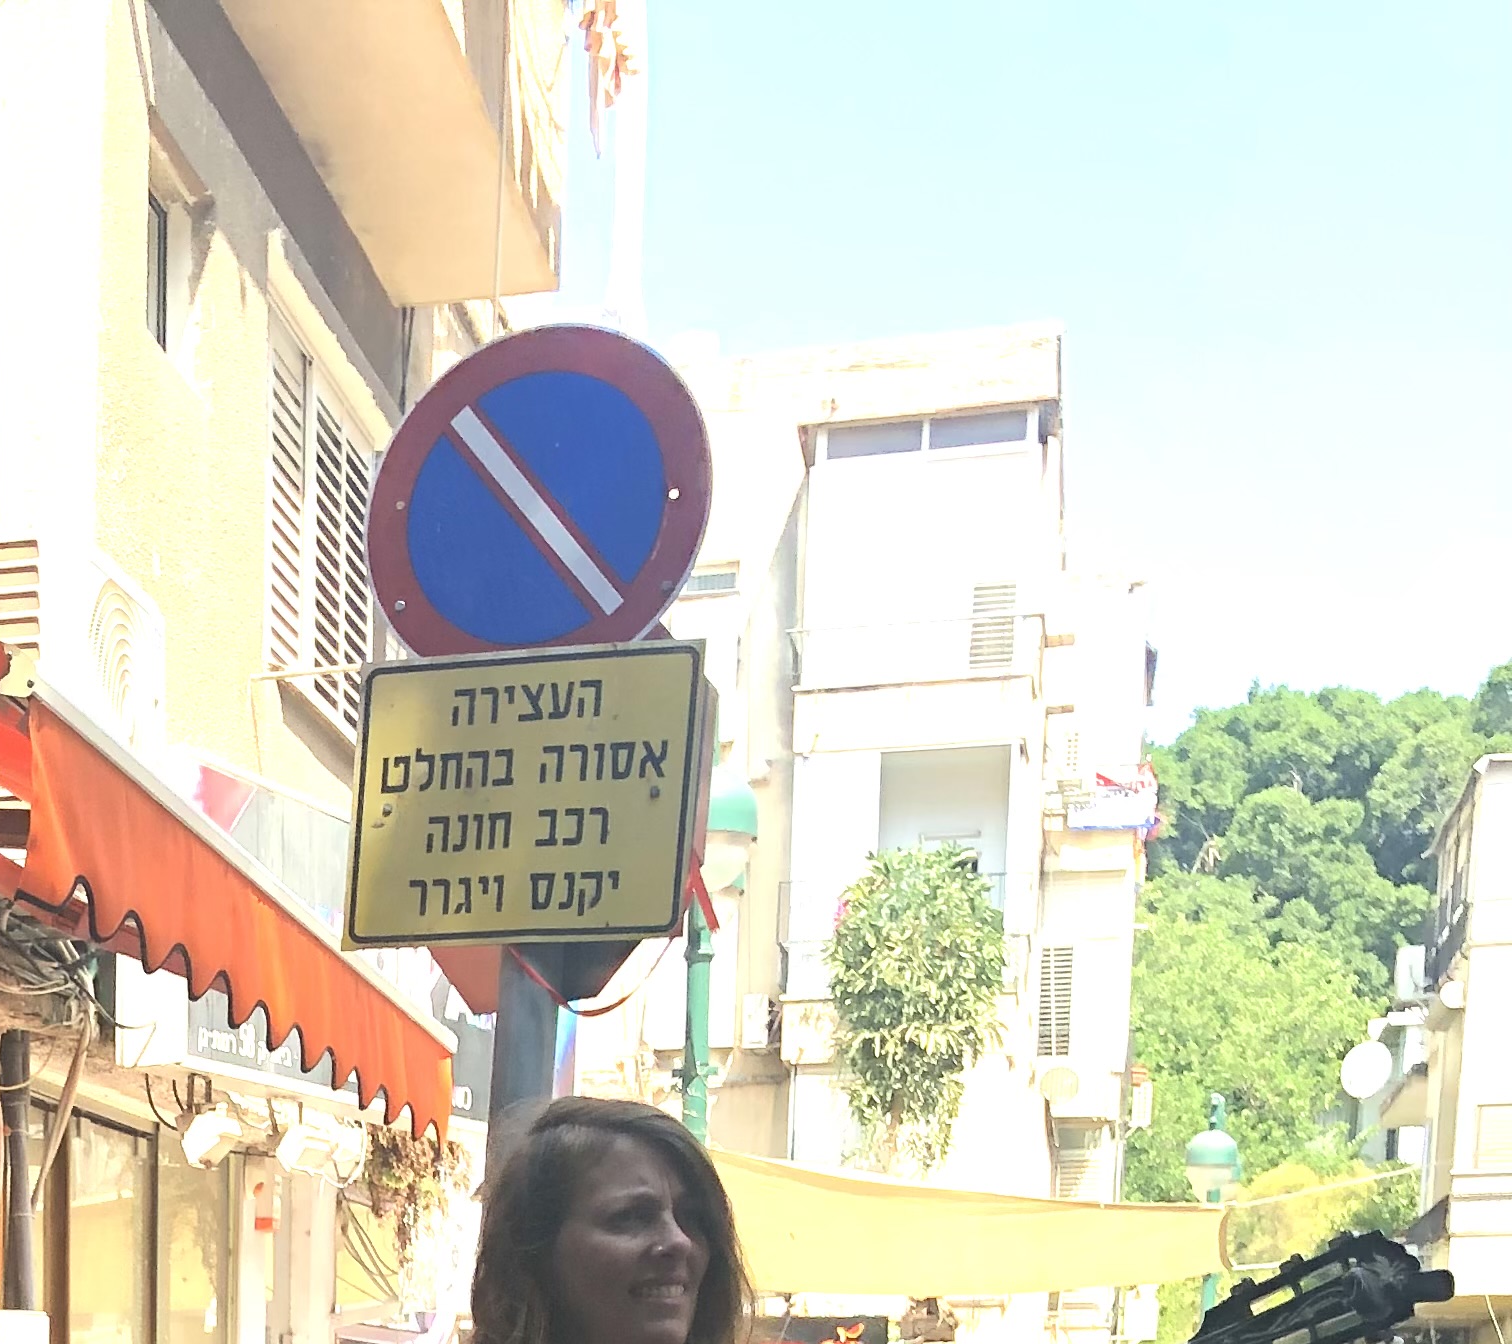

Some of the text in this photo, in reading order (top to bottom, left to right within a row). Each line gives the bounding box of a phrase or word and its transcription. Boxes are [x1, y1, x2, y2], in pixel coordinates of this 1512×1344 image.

[451, 679, 603, 727] העצירה
[380, 740, 668, 795] אסורה בהחלט
[425, 807, 610, 854] רכב חונה
[409, 870, 620, 917] יקנס ויגרר
